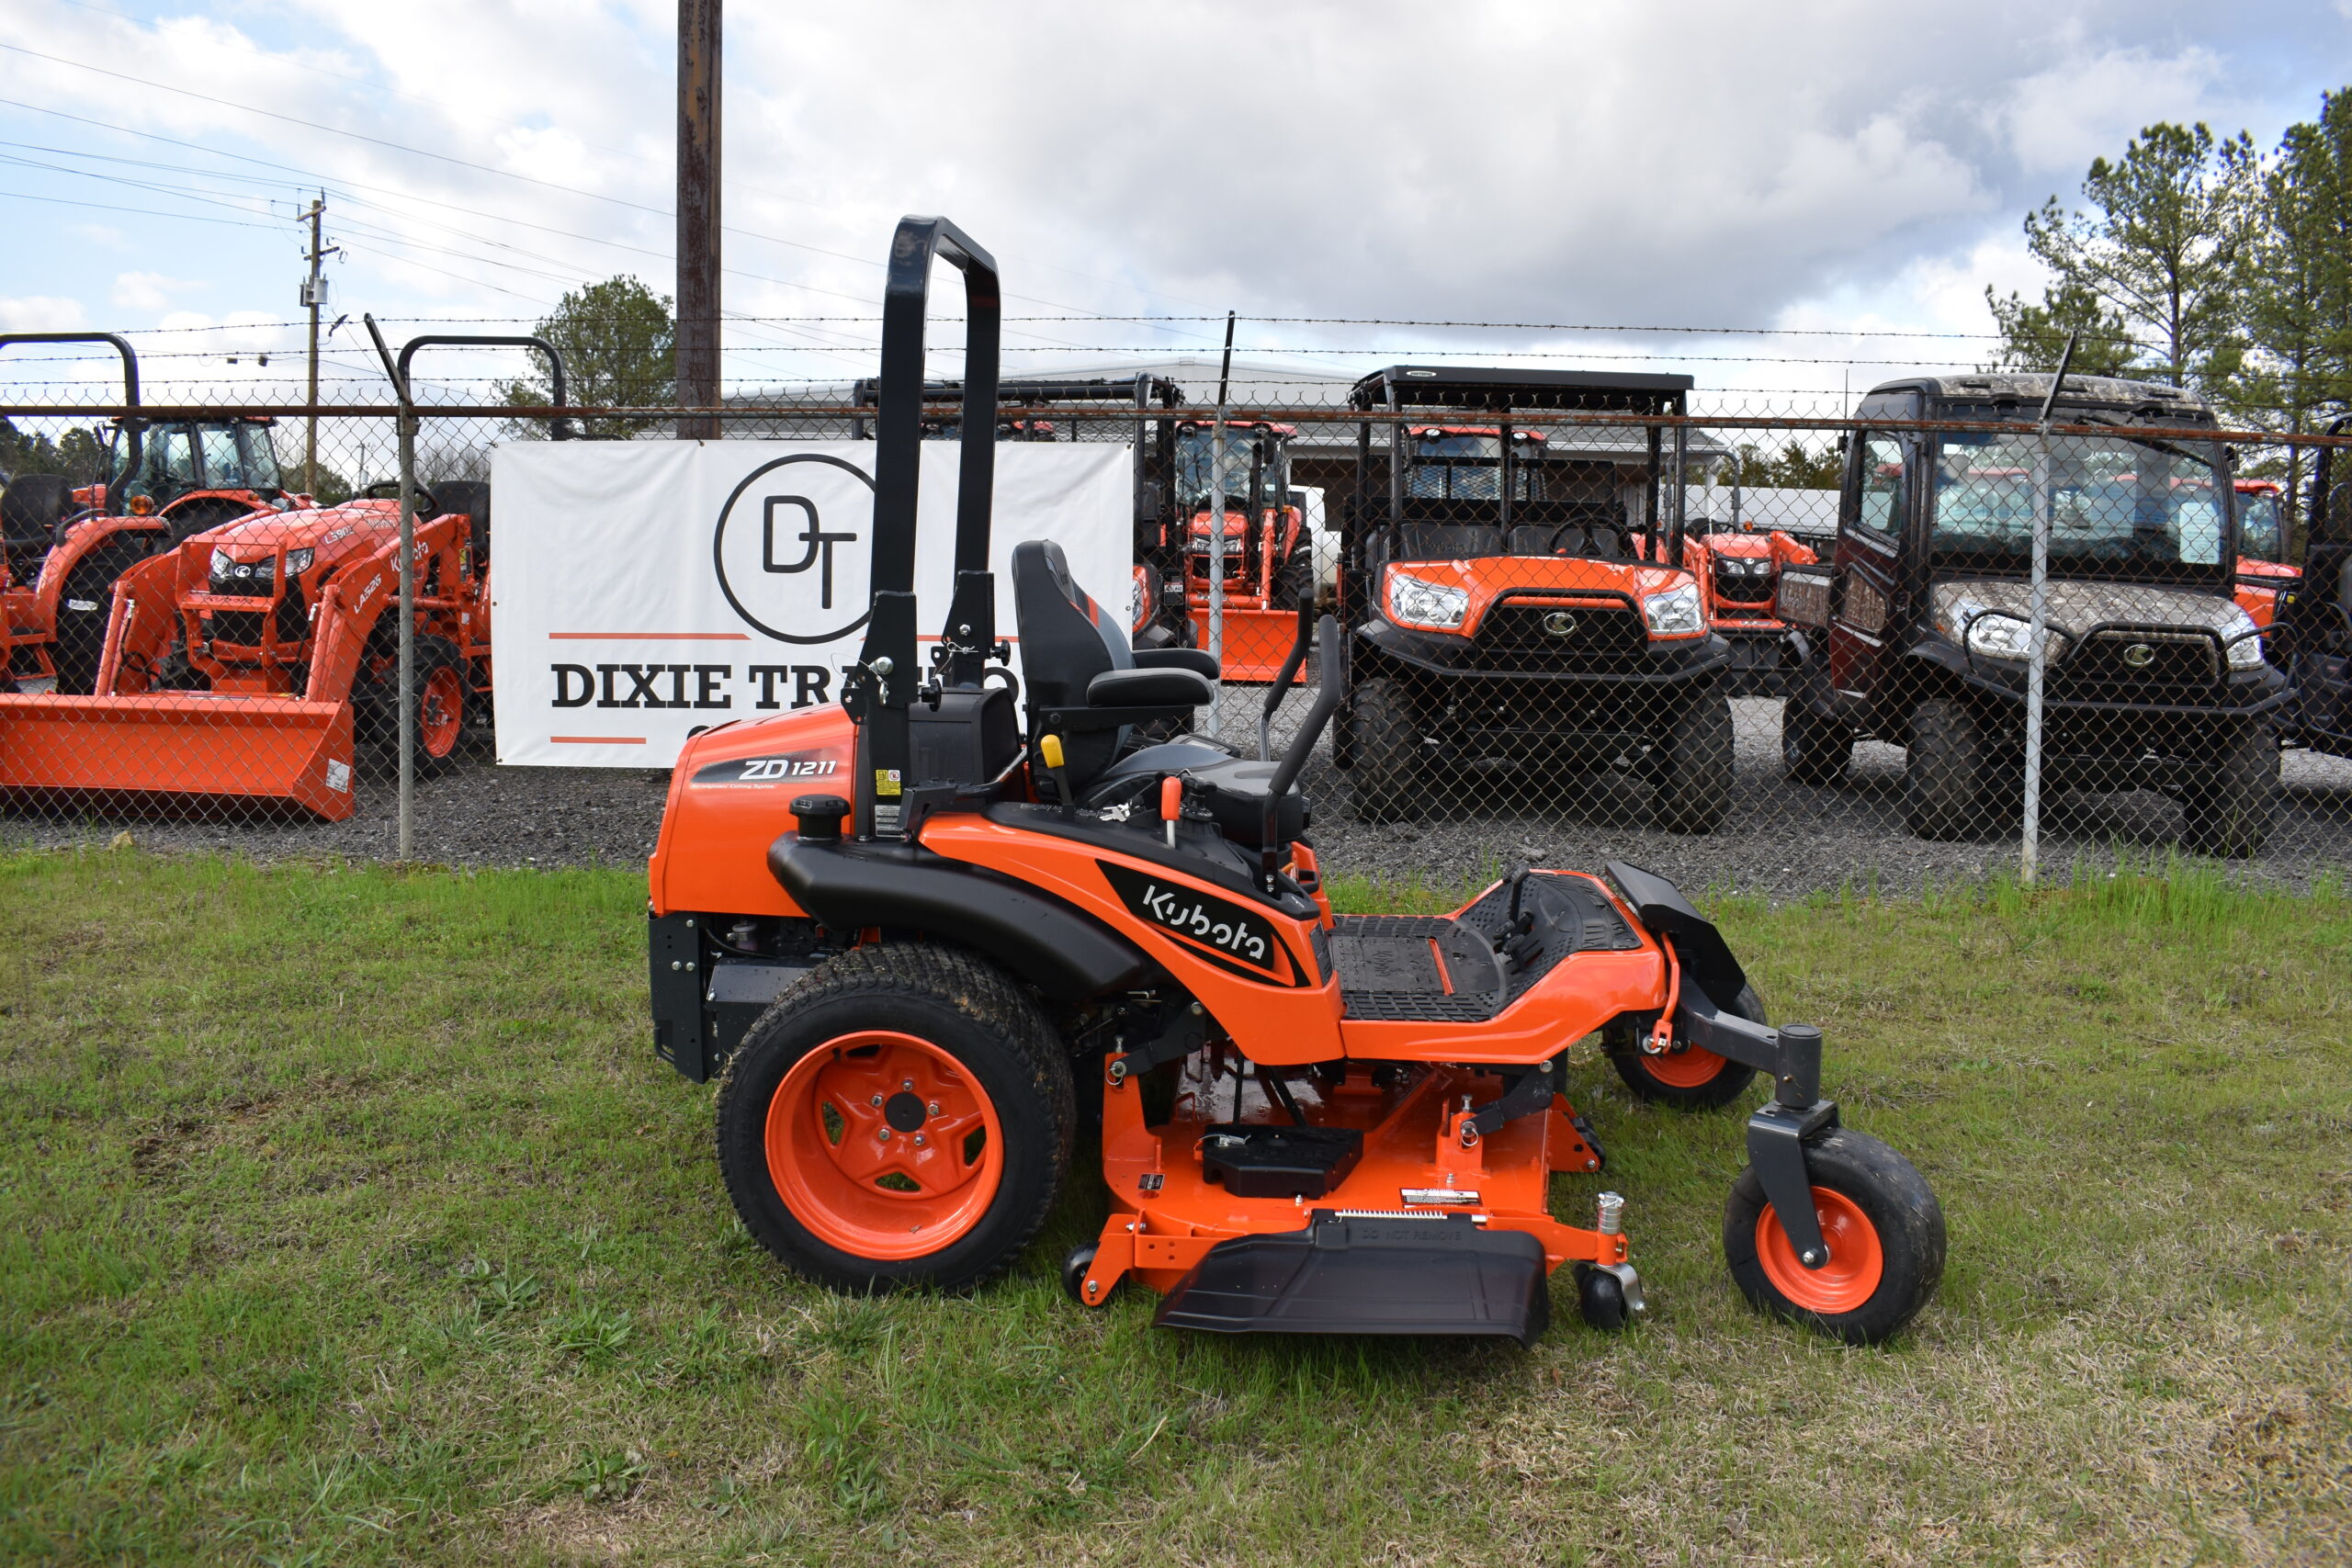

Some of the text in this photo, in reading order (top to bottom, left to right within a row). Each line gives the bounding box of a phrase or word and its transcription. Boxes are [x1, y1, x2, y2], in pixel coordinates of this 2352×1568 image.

[763, 495, 857, 609] DT
[550, 663, 731, 709] DIXIE
[1142, 884, 1266, 961] Kubota
